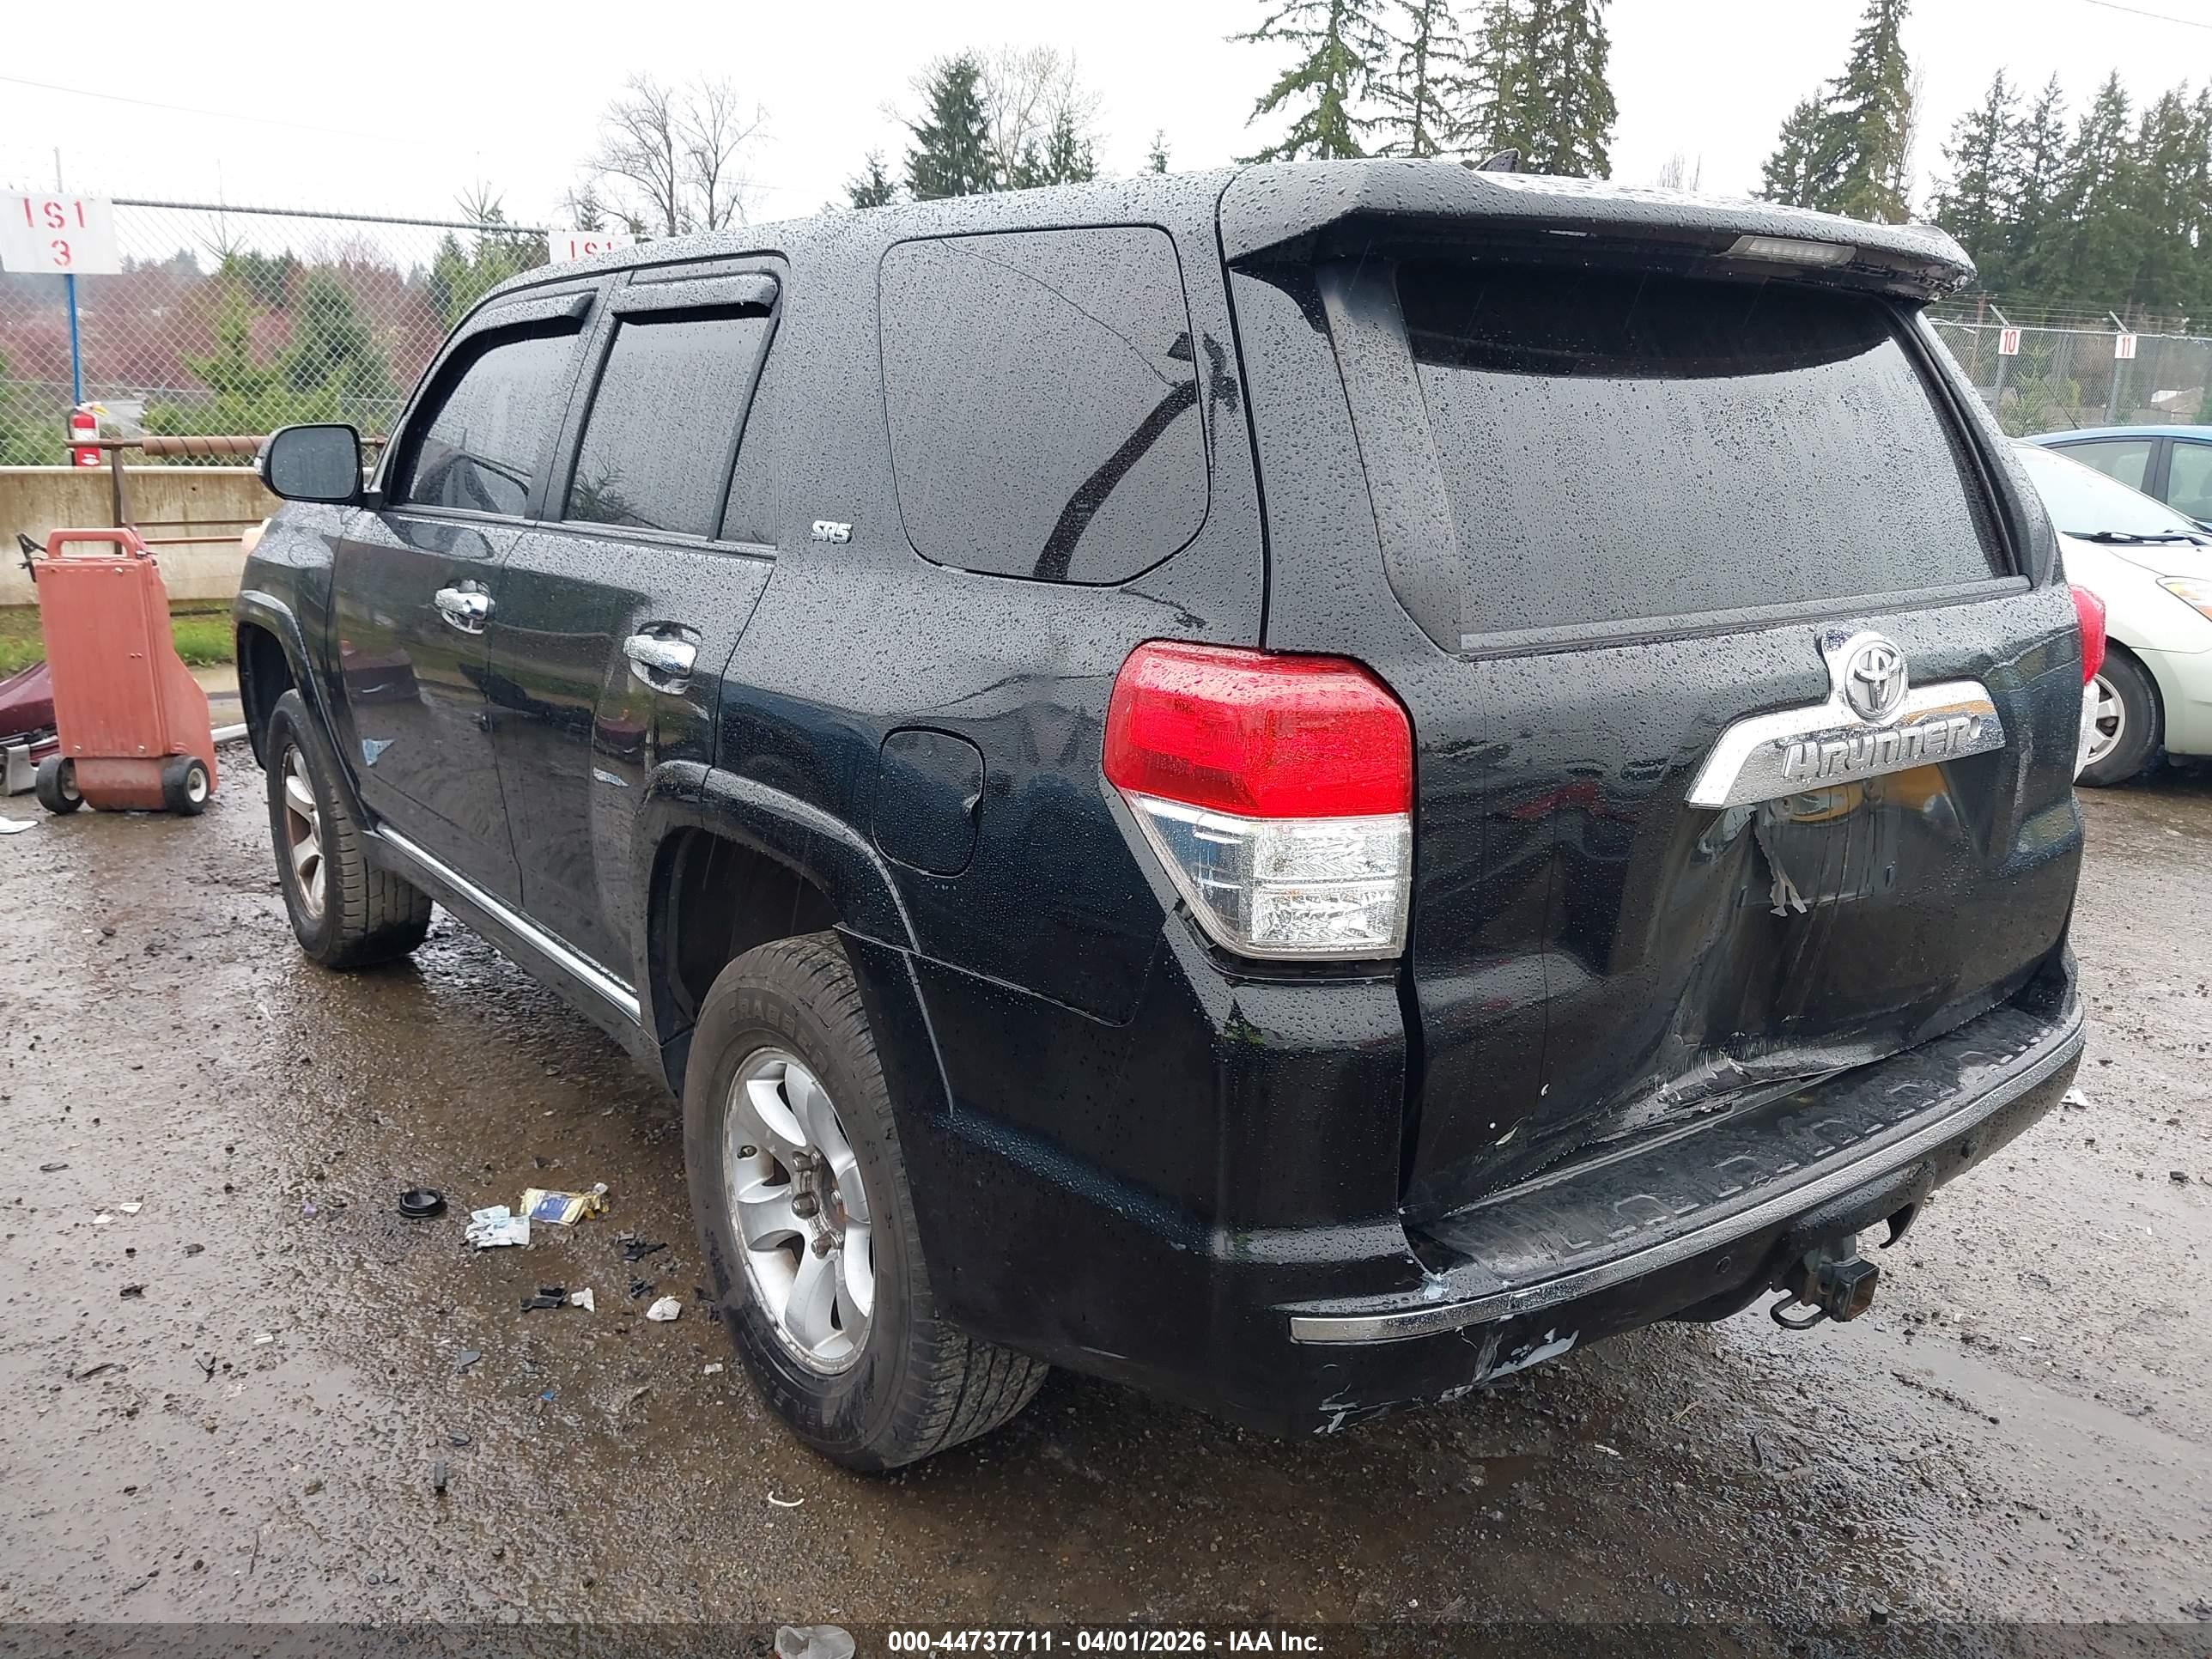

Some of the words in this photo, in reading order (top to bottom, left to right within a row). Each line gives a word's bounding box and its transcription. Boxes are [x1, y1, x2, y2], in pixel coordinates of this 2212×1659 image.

[51, 240, 71, 266] 3
[2003, 330, 2017, 354] 10
[2122, 336, 2131, 357] 11
[811, 520, 853, 544] SR5
